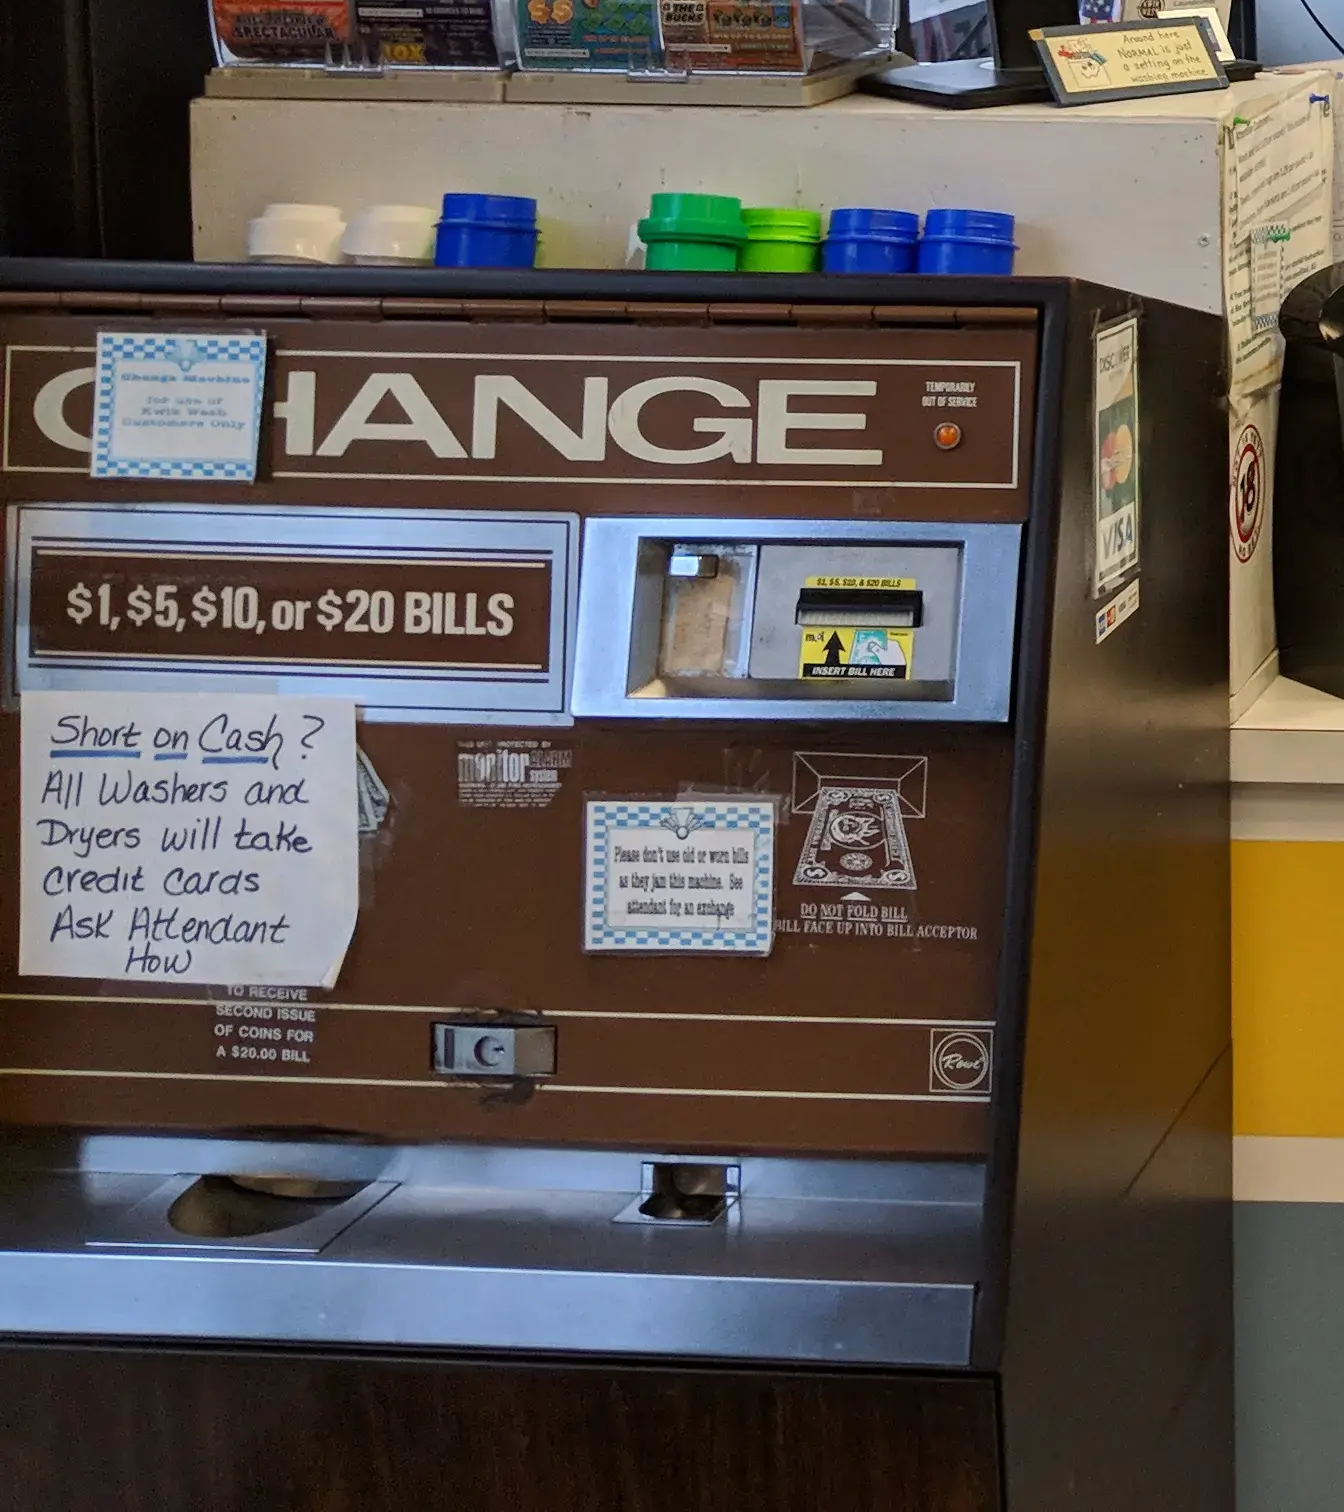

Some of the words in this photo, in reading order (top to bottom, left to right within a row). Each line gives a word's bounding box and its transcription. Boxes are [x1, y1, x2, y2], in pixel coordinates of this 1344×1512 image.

[1159, 31, 1180, 39] here
[1134, 58, 1171, 71] setting
[925, 381, 975, 393] TEMPORARILY
[922, 396, 936, 407] OUT
[947, 396, 978, 408] SERVICE
[1102, 512, 1133, 560] VISA
[65, 582, 120, 634] $1,
[126, 584, 187, 635] $5,
[191, 583, 266, 636] $10,
[271, 596, 313, 632] or
[317, 586, 395, 636] $20
[403, 587, 515, 638] BILLS
[812, 665, 847, 677] INSERT
[848, 666, 869, 677] BILL
[870, 666, 896, 678] HERE
[50, 715, 142, 749] Short
[153, 726, 189, 751] on
[198, 713, 283, 770] Cash
[458, 749, 530, 782] monitor
[41, 769, 83, 810] All
[99, 770, 228, 806] Washers
[244, 779, 310, 805] and
[36, 819, 142, 858] Dryers
[161, 818, 219, 852] will
[234, 818, 313, 853] take
[614, 846, 640, 862] Please
[631, 873, 649, 892] they
[651, 874, 666, 892] jam
[669, 873, 685, 889] this
[729, 873, 743, 890] See
[627, 899, 667, 915] attendant
[801, 903, 817, 918] DO
[820, 903, 843, 919] NOT
[847, 904, 879, 920] FOLD
[881, 905, 908, 921] BILL
[128, 906, 292, 944] Attendant
[804, 920, 833, 935] FACE
[836, 921, 853, 935] UP
[854, 921, 883, 936] INTO
[887, 922, 914, 937] BILL
[916, 923, 978, 939] ACCEPTOR
[248, 987, 308, 1001] RECEIVE
[215, 1006, 273, 1020] SECOND
[276, 1007, 316, 1022] ISSUE
[214, 1024, 234, 1037] OF
[238, 1026, 282, 1040] COINS
[286, 1028, 314, 1043] FOR
[216, 1046, 227, 1058] A
[231, 1046, 277, 1061] $20.00
[282, 1048, 310, 1063] BILL
